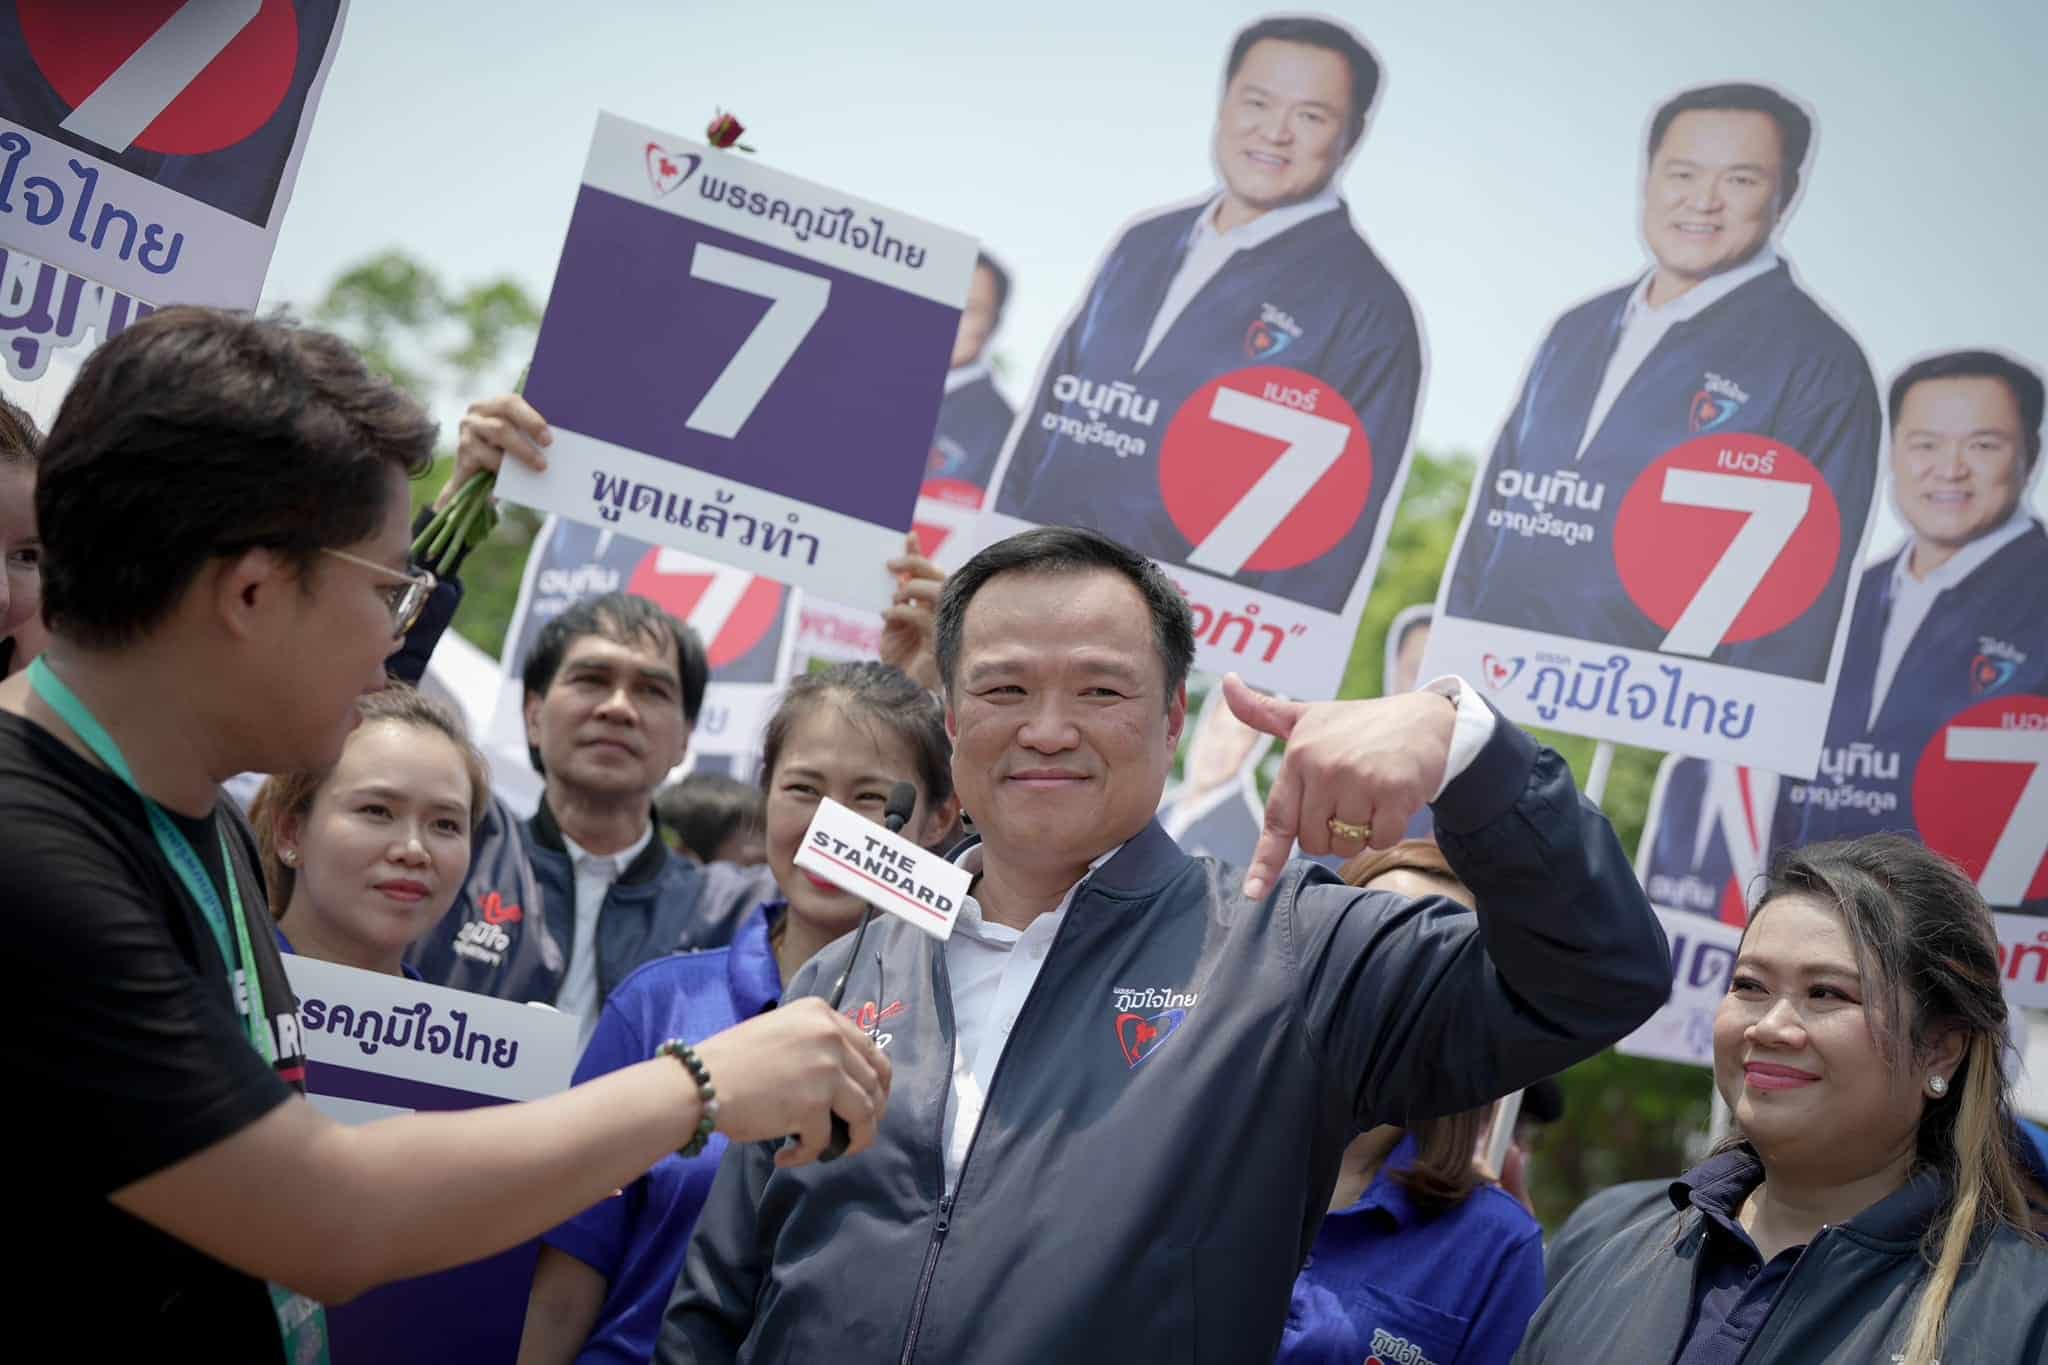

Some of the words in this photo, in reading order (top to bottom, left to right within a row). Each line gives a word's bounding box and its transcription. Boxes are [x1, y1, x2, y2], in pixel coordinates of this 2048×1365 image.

[700, 174, 927, 269] พรรคภูมิใจไทย
[684, 241, 832, 439] 7
[1053, 374, 1160, 426] อนุทิน
[592, 470, 820, 566] พูดแล้วทำ
[1186, 386, 1352, 578] 7
[1496, 469, 1605, 514] อนุทิน
[1657, 467, 1812, 658] 7
[1527, 655, 1755, 739] ภูมิใจไทย
[812, 831, 953, 912] STANDARD
[864, 835, 916, 874] THE
[294, 997, 519, 1069] รคภูมิใจไทย
[1114, 988, 1198, 1012] ภูมิใจไทย
